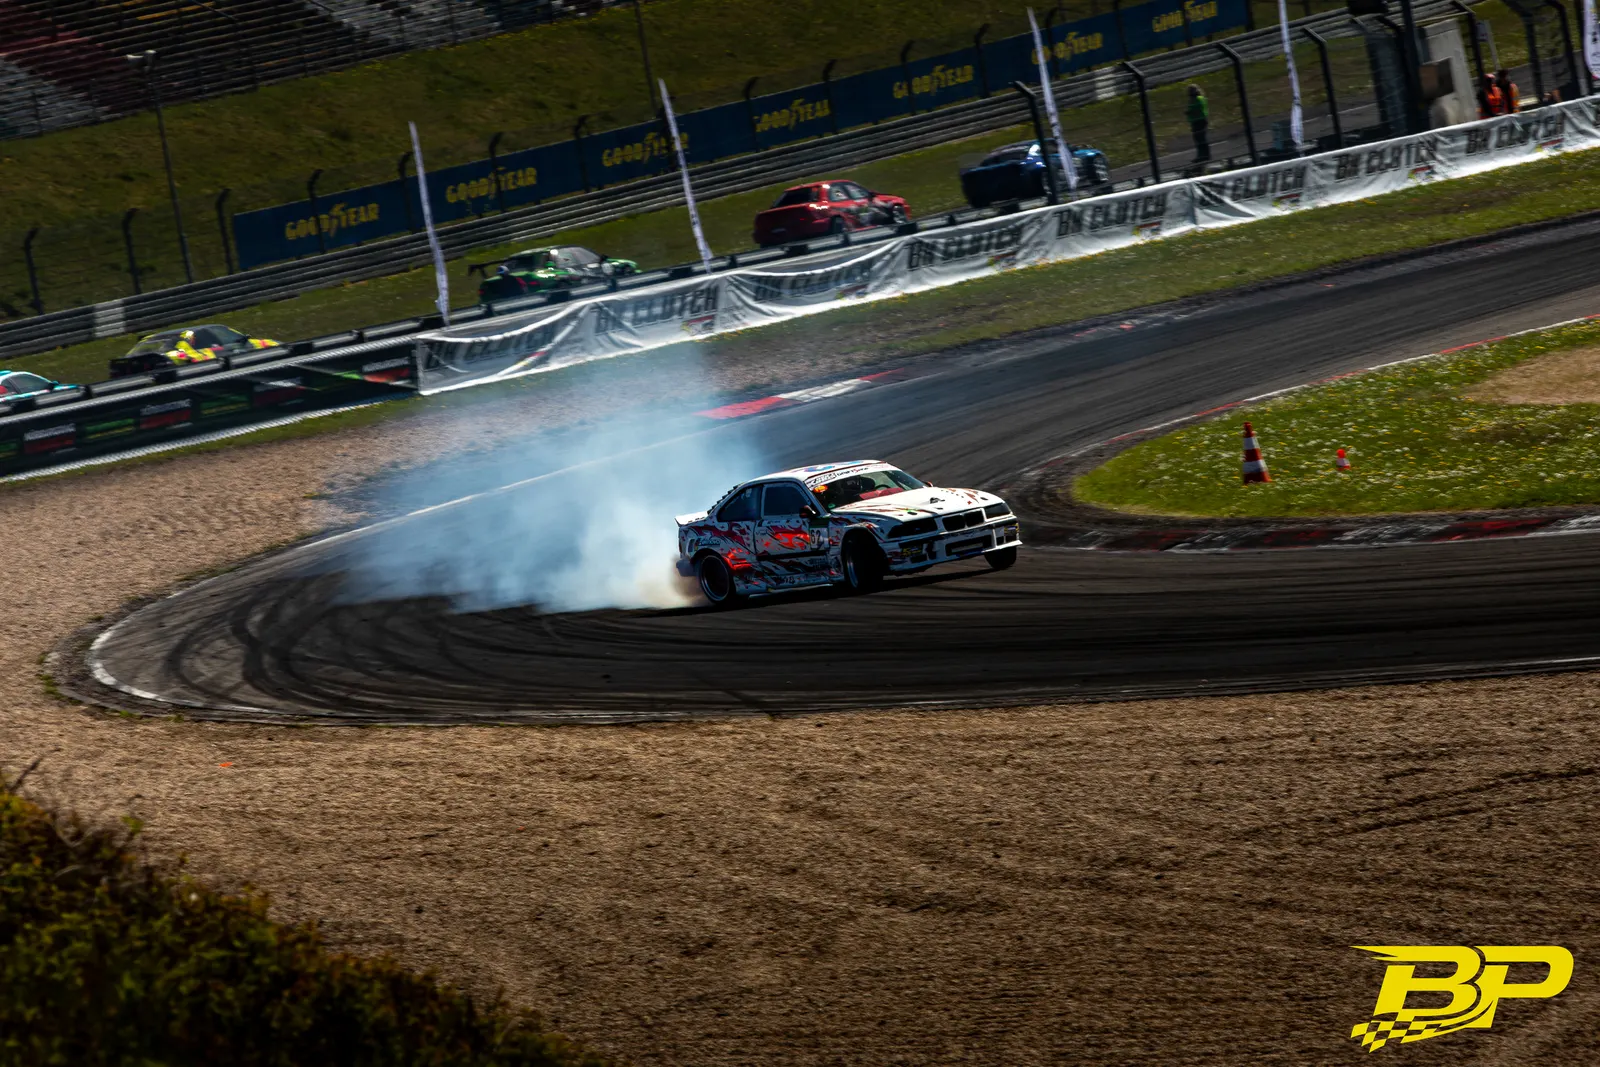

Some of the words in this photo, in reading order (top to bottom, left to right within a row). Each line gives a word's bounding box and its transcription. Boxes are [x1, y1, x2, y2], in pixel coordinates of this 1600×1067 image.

[1152, 0, 1218, 33] GOODYEAR
[892, 63, 974, 97] GOODYEAR
[444, 166, 538, 204] GOODYEAR
[284, 201, 381, 241] GOODYEAR
[1089, 193, 1167, 230] CLUTCH
